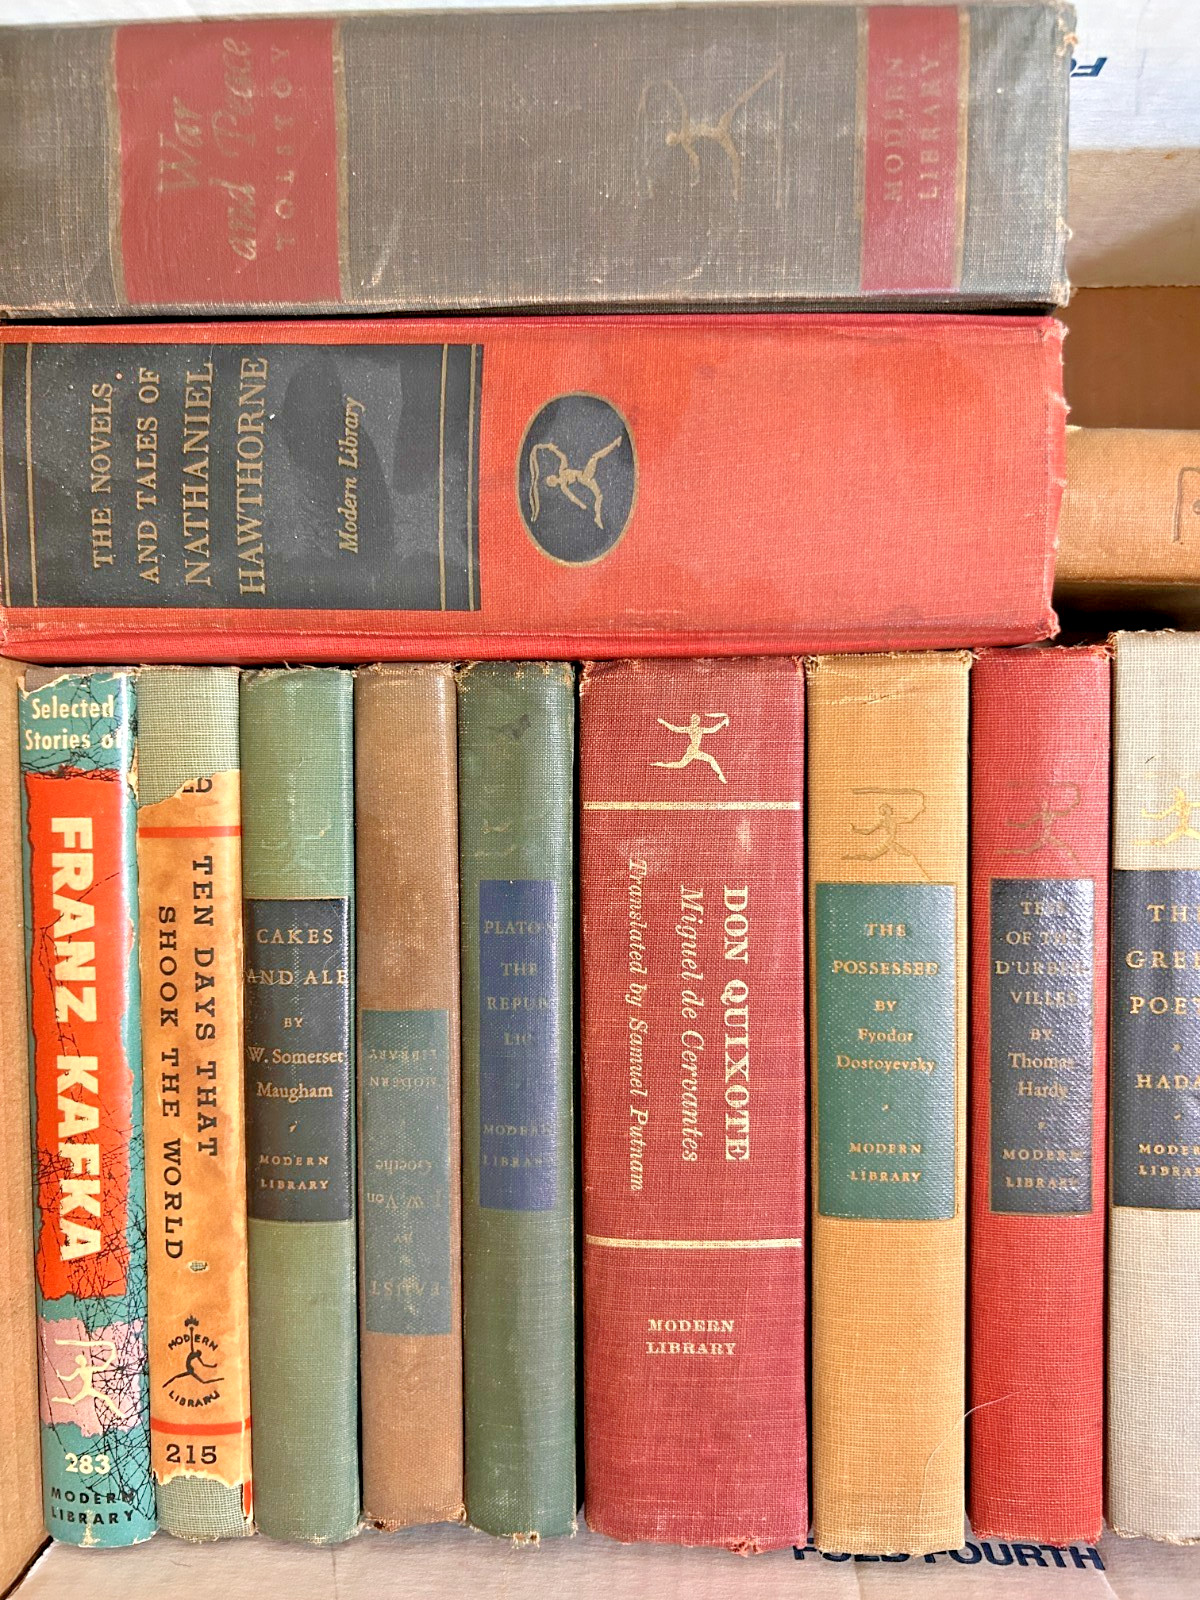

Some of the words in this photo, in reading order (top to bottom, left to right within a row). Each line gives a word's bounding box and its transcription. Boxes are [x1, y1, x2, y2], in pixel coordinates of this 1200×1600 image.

[212, 37, 256, 159] Peace
[882, 56, 905, 202] MODERN
[918, 57, 941, 200] LIBRARY
[157, 96, 202, 193] War
[271, 44, 297, 252] TOLSTOY
[209, 177, 257, 261] and
[138, 367, 161, 403] OF
[91, 382, 113, 493] NOVELS
[337, 397, 366, 470] Library
[136, 416, 158, 511] TALES
[182, 362, 213, 587] NATHANIEL
[236, 357, 268, 595] HAWTHORNE
[337, 477, 359, 554] Modern
[92, 507, 114, 568] THE
[137, 520, 161, 584] AND
[31, 694, 114, 720] Selected
[24, 727, 92, 751] Stories
[192, 855, 214, 926] TEN
[51, 817, 97, 1022] FRANZ
[628, 858, 648, 975] Translated
[724, 884, 749, 965] DON
[256, 928, 334, 945] CAKES
[675, 885, 705, 981] Miguel
[866, 922, 907, 938] THE
[1005, 930, 1033, 945] OF
[158, 905, 179, 1027] SHOOK
[247, 968, 294, 986] AND
[303, 969, 350, 986] ALE
[501, 961, 538, 977] THE
[832, 960, 939, 976] POSSESSED
[194, 947, 216, 1041] DAYS
[625, 982, 648, 1007] by
[681, 989, 705, 1019] de
[874, 1000, 897, 1012] BY
[1010, 991, 1079, 1006] VILLES
[283, 1017, 303, 1029] BY
[1030, 1028, 1054, 1041] BY
[858, 1028, 914, 1043] Fyodor
[248, 1046, 270, 1064] W.
[271, 1048, 345, 1065] Somerset
[368, 1048, 438, 1061] LIBRARY
[628, 1016, 649, 1097] Samuel
[836, 1055, 936, 1075] Dostoyevsky
[1008, 1052, 1075, 1070] Thomas
[161, 1047, 181, 1118] THE
[370, 1075, 437, 1088] MODERN
[720, 979, 750, 1162] QUIXOTE
[256, 1081, 335, 1104] Maugham
[680, 1030, 705, 1162] Cervantes
[1017, 1081, 1069, 1100] Hardy
[196, 1060, 218, 1156] THAT
[57, 1055, 102, 1261] KAFKA
[629, 1104, 649, 1191] Putnam
[849, 1142, 922, 1154] MODERN
[1002, 1149, 1083, 1162] MODERN
[259, 1154, 329, 1167] MODERN
[376, 1159, 433, 1175] Goethe
[260, 1178, 329, 1191] LIBRARY
[850, 1170, 922, 1183] LIBRARY
[1005, 1177, 1079, 1190] LIBRARY
[163, 1137, 184, 1259] WORLD
[647, 1319, 735, 1333] MODERN
[167, 1333, 219, 1351] MODERN
[645, 1341, 737, 1355] LIBRARY
[168, 1389, 221, 1408] LIBRARY
[64, 1452, 111, 1475] 283
[165, 1443, 218, 1465] 215
[51, 1486, 136, 1506] MODERN
[51, 1505, 134, 1526] LIBRARY
